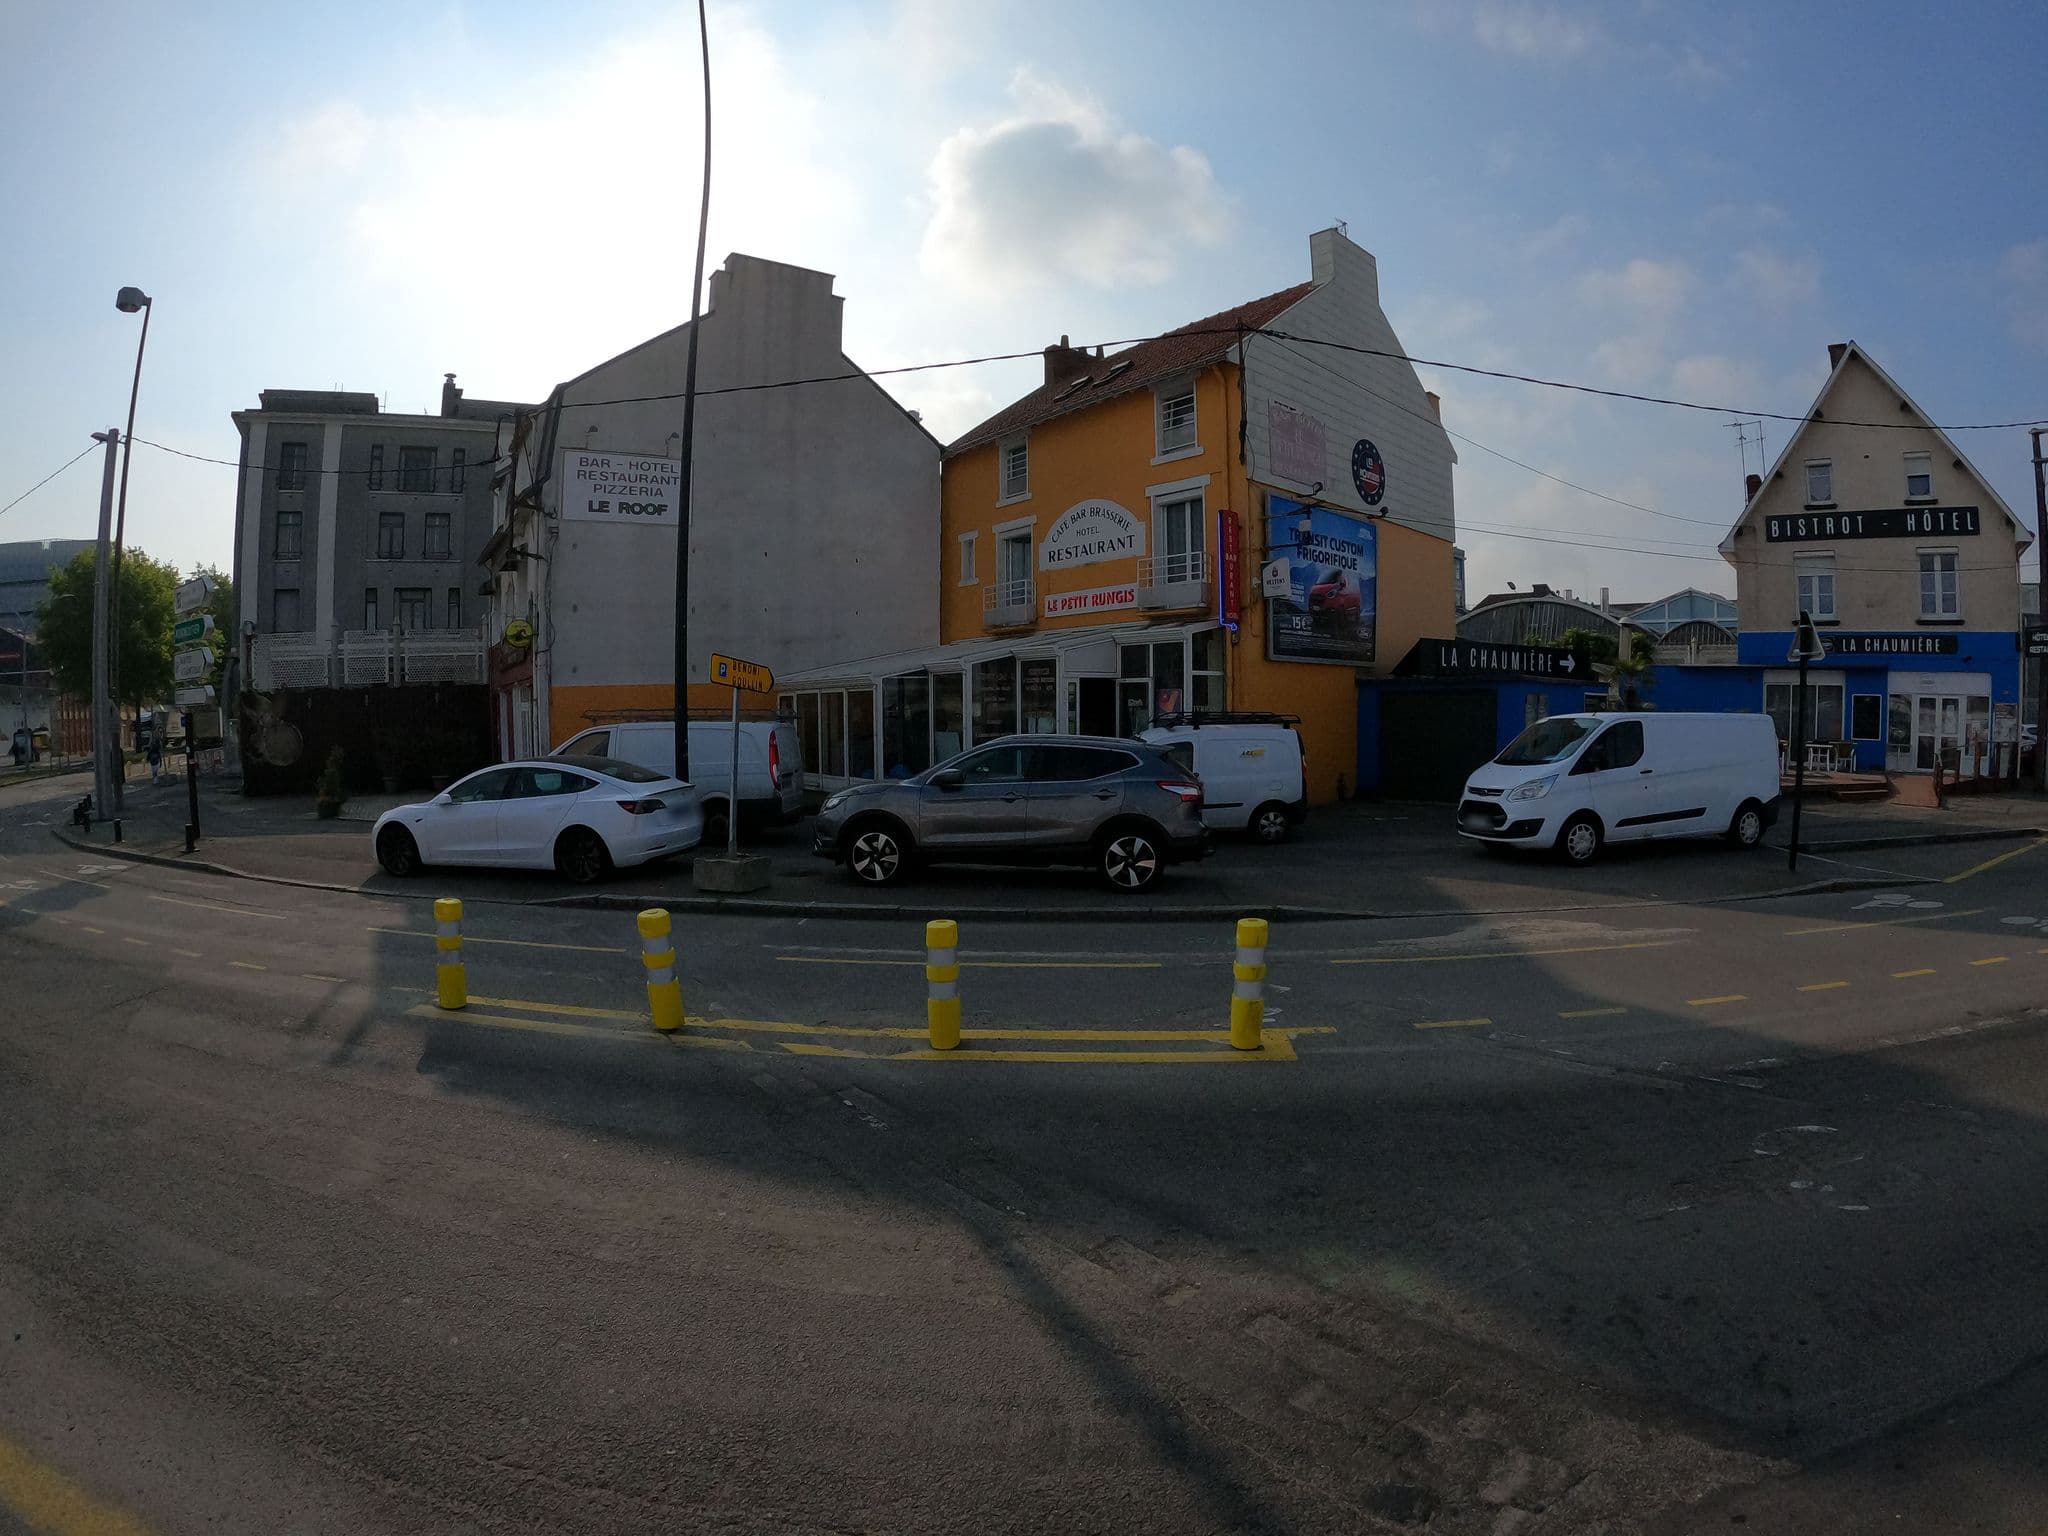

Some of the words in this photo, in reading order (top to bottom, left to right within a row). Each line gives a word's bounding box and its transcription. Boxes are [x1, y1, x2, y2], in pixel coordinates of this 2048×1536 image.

[579, 456, 611, 468] BAR
[628, 461, 679, 474] HOTEL
[576, 469, 680, 486] RESTAURANT
[593, 483, 665, 497] PIZZERIA
[588, 500, 610, 513] LE
[618, 501, 668, 516] ROOF
[1070, 508, 1087, 524] BAR
[1089, 506, 1133, 533] BRASSERIE
[1771, 515, 1864, 538] BISTROT
[1907, 510, 1975, 532] HÔTEL
[1076, 525, 1100, 537] HOTEL
[1048, 534, 1136, 563] RESTAURANT
[1297, 544, 1358, 571] FRIGORIFIQUE
[1329, 537, 1364, 558] CUSTOM
[1047, 600, 1058, 613] LE
[1061, 595, 1088, 610] PETIT
[1091, 588, 1135, 607] RUNGIS
[1842, 639, 1856, 652] LA
[1864, 636, 1940, 653] CHAUMIÈRE
[1441, 646, 1458, 668] LA
[1470, 647, 1552, 673] CHAUMIÈRE
